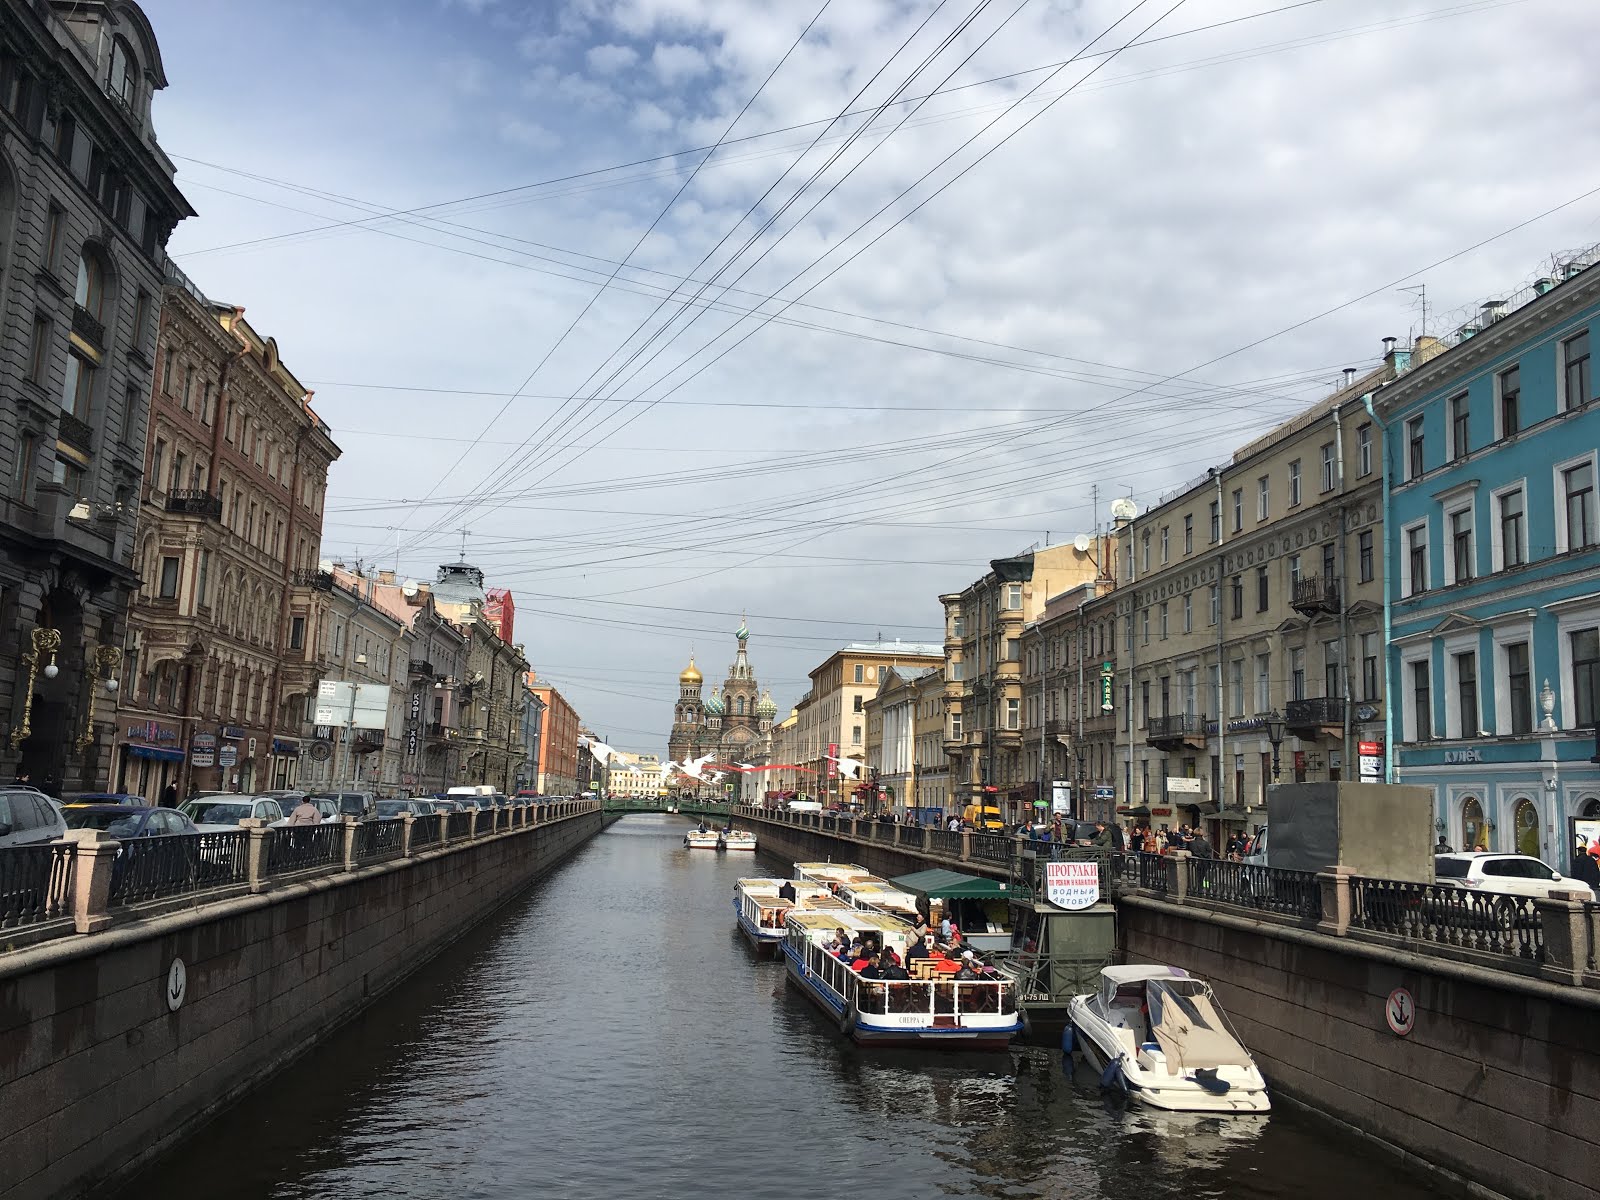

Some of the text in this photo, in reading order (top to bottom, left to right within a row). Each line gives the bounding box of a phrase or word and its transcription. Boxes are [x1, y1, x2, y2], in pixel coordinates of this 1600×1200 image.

[411, 693, 420, 718] КОФЕ
[408, 730, 417, 755] ХАУЗ
[1444, 746, 1483, 763] кулёк
[1048, 864, 1098, 877] ПРОГУЛКИ
[1052, 887, 1095, 896] ВОДНЫЙ
[1052, 895, 1095, 905] АВТОБУС
